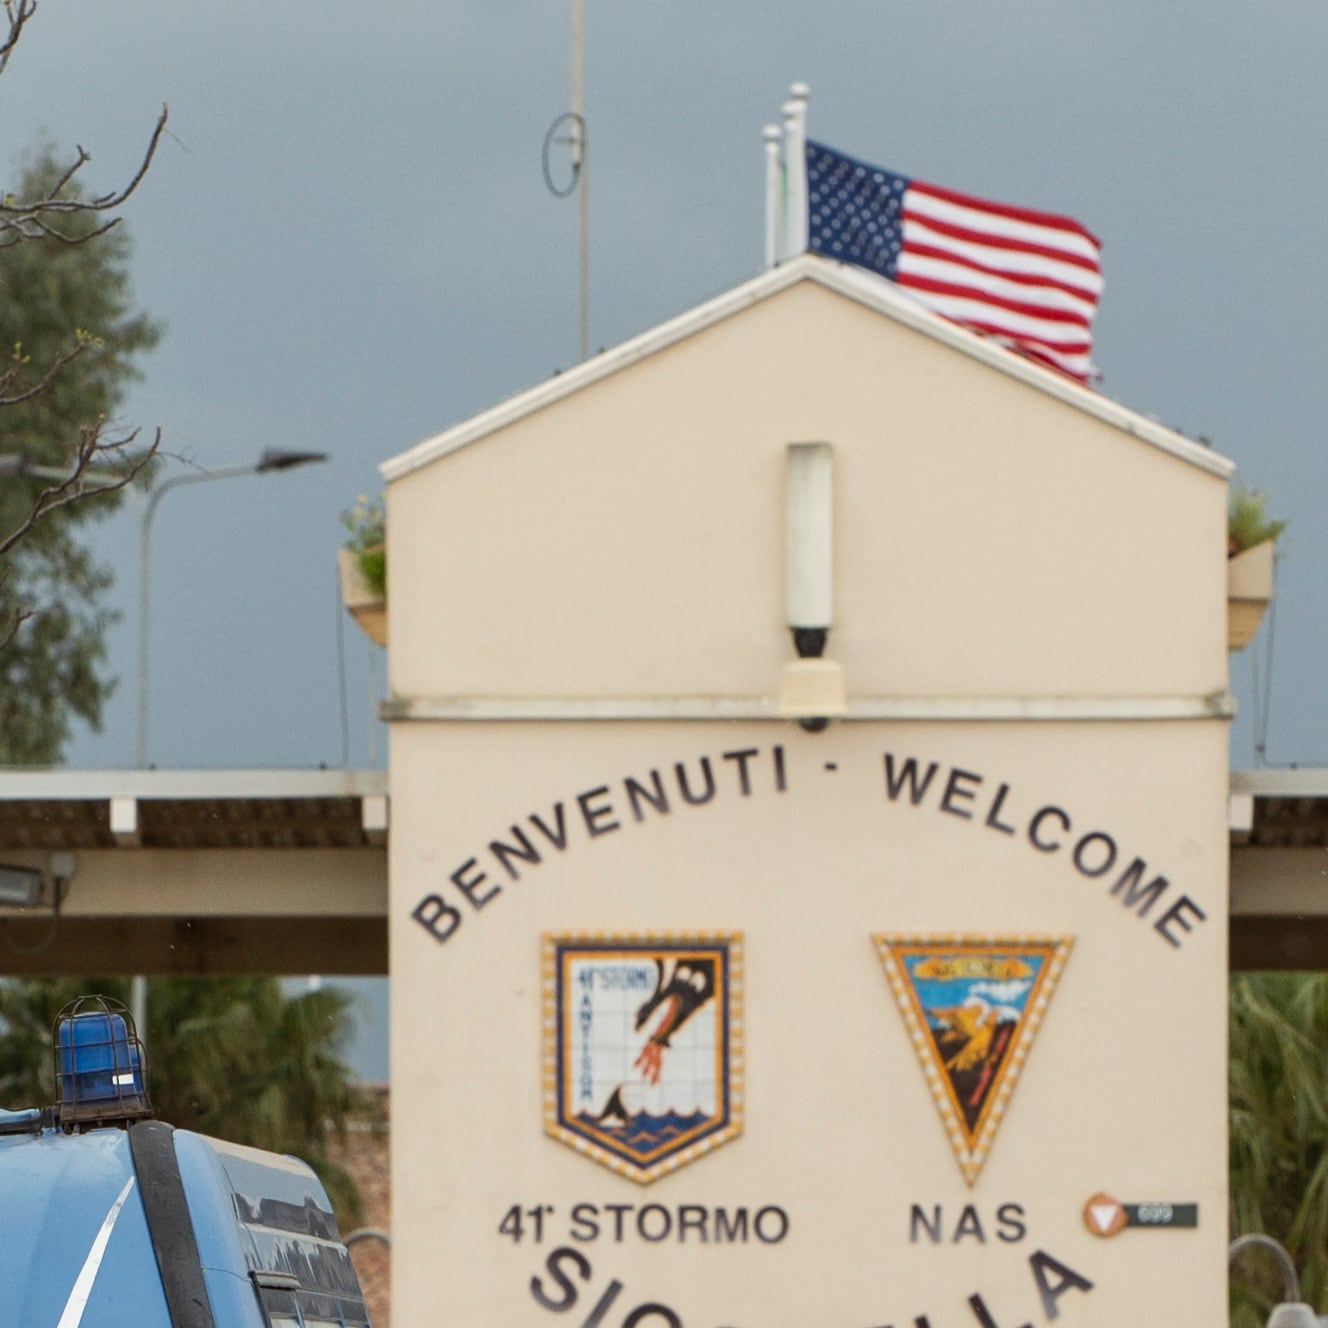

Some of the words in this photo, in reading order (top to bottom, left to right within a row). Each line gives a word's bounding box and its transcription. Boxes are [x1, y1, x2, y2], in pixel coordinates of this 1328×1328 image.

[410, 744, 788, 944] BENVENUTI
[883, 752, 1206, 949] WELCOME
[569, 1203, 790, 1244] STORMO
[909, 1203, 1027, 1243] NAS
